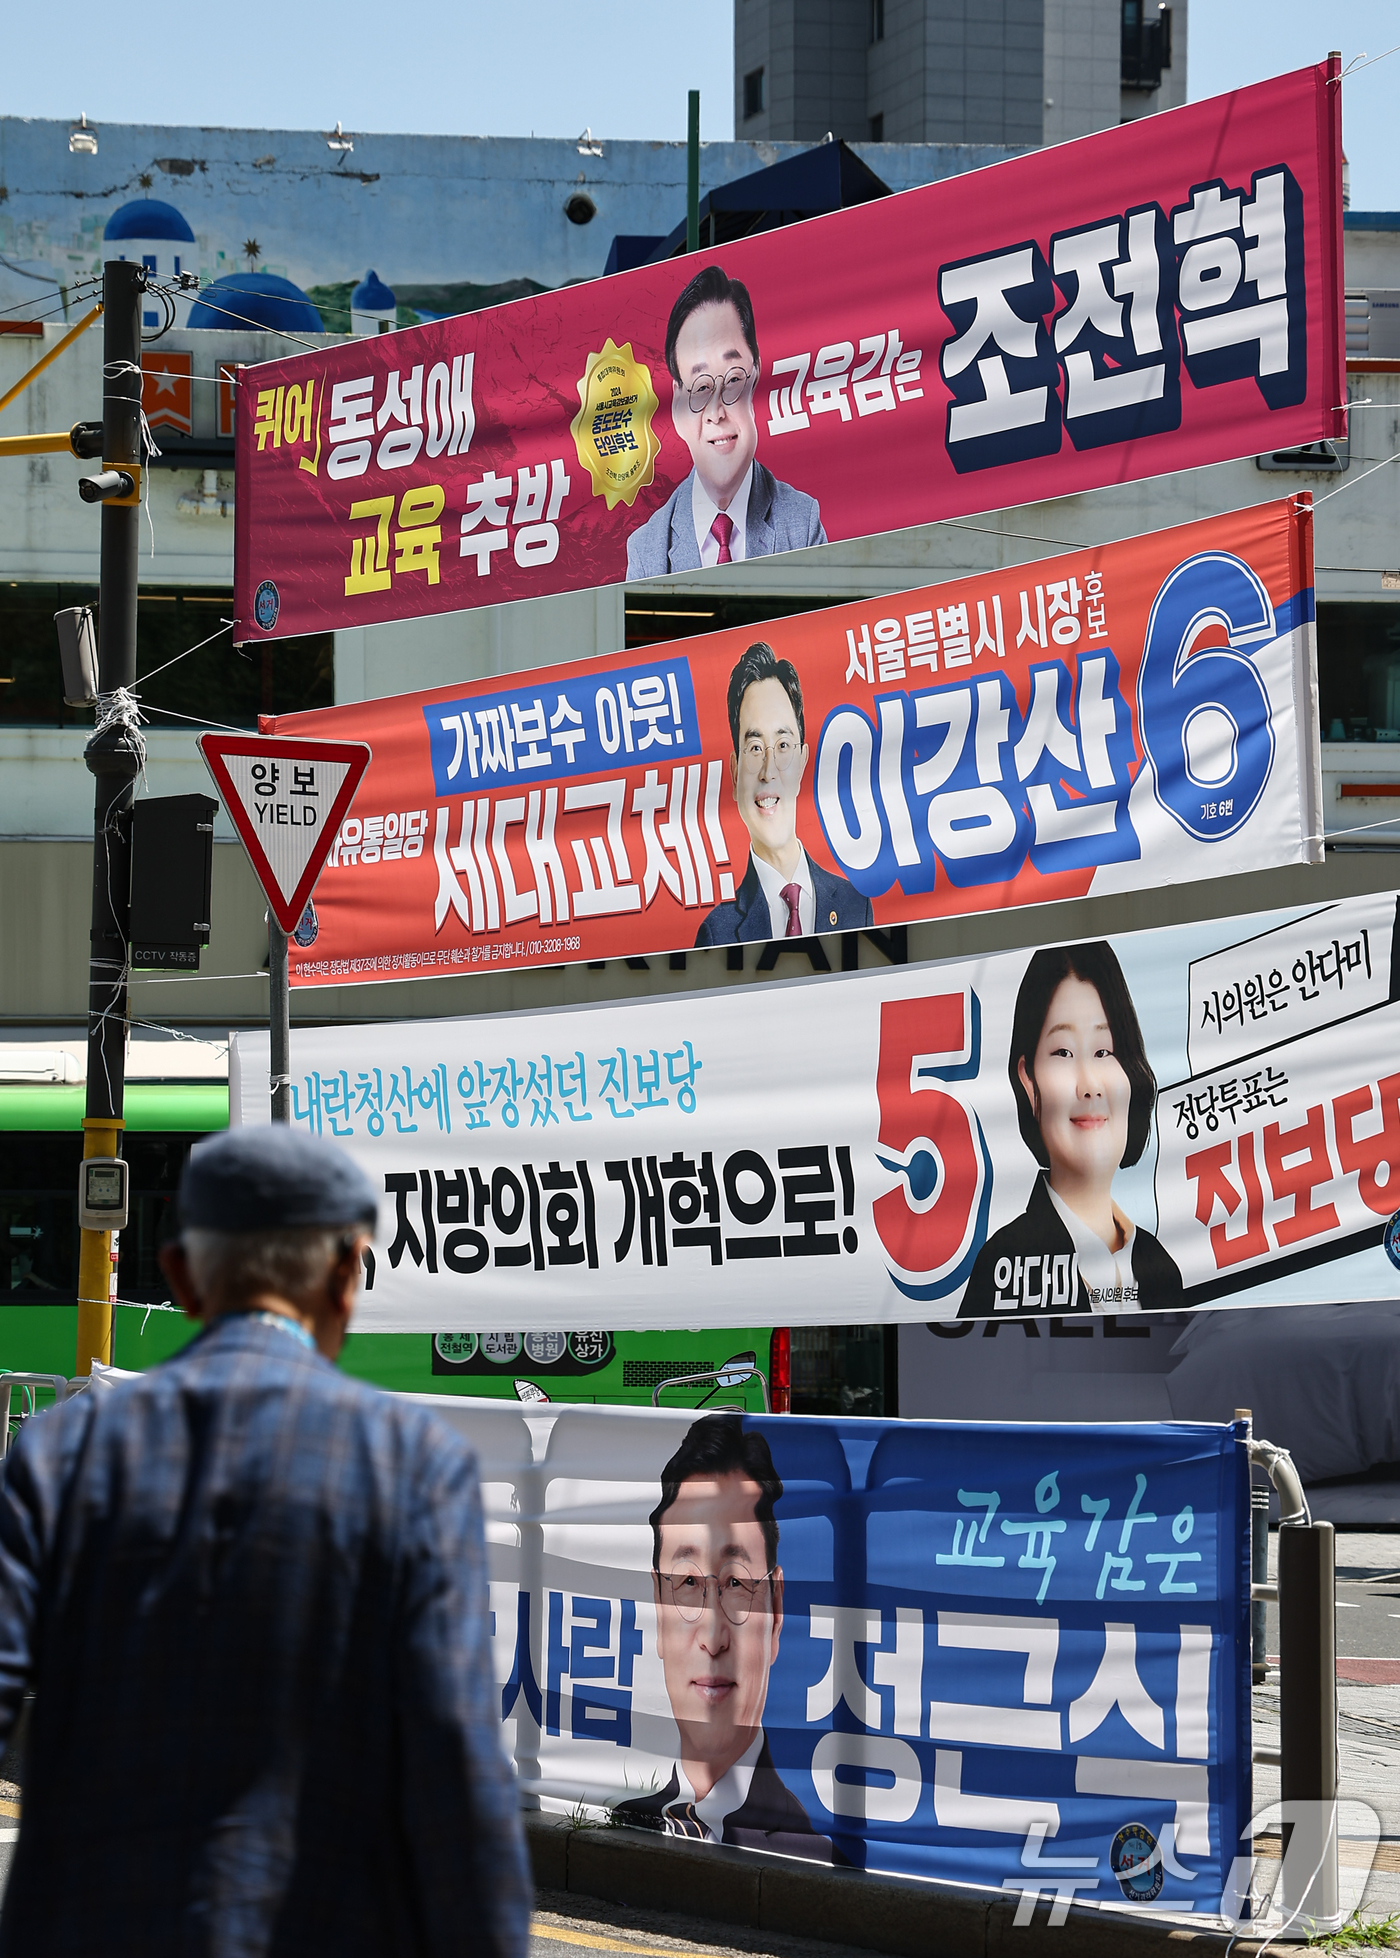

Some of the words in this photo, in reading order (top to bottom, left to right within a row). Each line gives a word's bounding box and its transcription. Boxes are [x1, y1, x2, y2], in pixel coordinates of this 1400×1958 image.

[939, 168, 1292, 446] 조전혁
[253, 379, 315, 452] 퀴어
[326, 352, 476, 480] 동성애
[592, 409, 633, 434] 중도보수
[767, 328, 925, 437] 교육감은
[593, 430, 639, 457] 단일후보
[344, 483, 446, 598] 교육
[459, 458, 571, 577] 추방
[845, 594, 1006, 684] 서울특별시
[1016, 576, 1083, 649] 시장
[1084, 570, 1109, 640] 후보
[440, 701, 586, 781] 가짜보수
[595, 673, 684, 756] 아웃!
[1137, 550, 1277, 843] 6
[254, 802, 318, 827] YIELD
[816, 655, 1117, 871] 이강산
[1200, 802, 1218, 820] 기호
[1218, 798, 1234, 816] 6번
[433, 759, 736, 936] 세대교체!
[135, 950, 166, 960] CCTV
[170, 951, 197, 963] 작동중
[295, 963, 303, 977] 이
[330, 959, 350, 976] 정당법
[378, 954, 391, 971] 의한
[436, 950, 450, 966] 무단
[471, 944, 491, 962] 철거를
[1201, 968, 1290, 1035] 시의원은
[1291, 928, 1372, 1002] 안다미
[290, 1062, 451, 1139] 내란청산에
[457, 1050, 593, 1131] 앞장섰던
[597, 1040, 703, 1120] 진보당
[872, 990, 982, 1275] 5
[1172, 1066, 1289, 1140] 정당투표는
[384, 1158, 599, 1276] 지방의회
[604, 1145, 859, 1268] 개혁으로!
[1184, 1070, 1400, 1271] 진보당
[993, 1251, 1080, 1311] 안다미
[440, 1342, 473, 1354] 전철역
[485, 1343, 518, 1354] 도서관
[531, 1343, 558, 1357] 병원
[575, 1343, 604, 1358] 상가
[936, 1470, 1202, 1606] 교육감은
[805, 1601, 1217, 1857] 정근식
[1121, 1853, 1151, 1878] 선거
